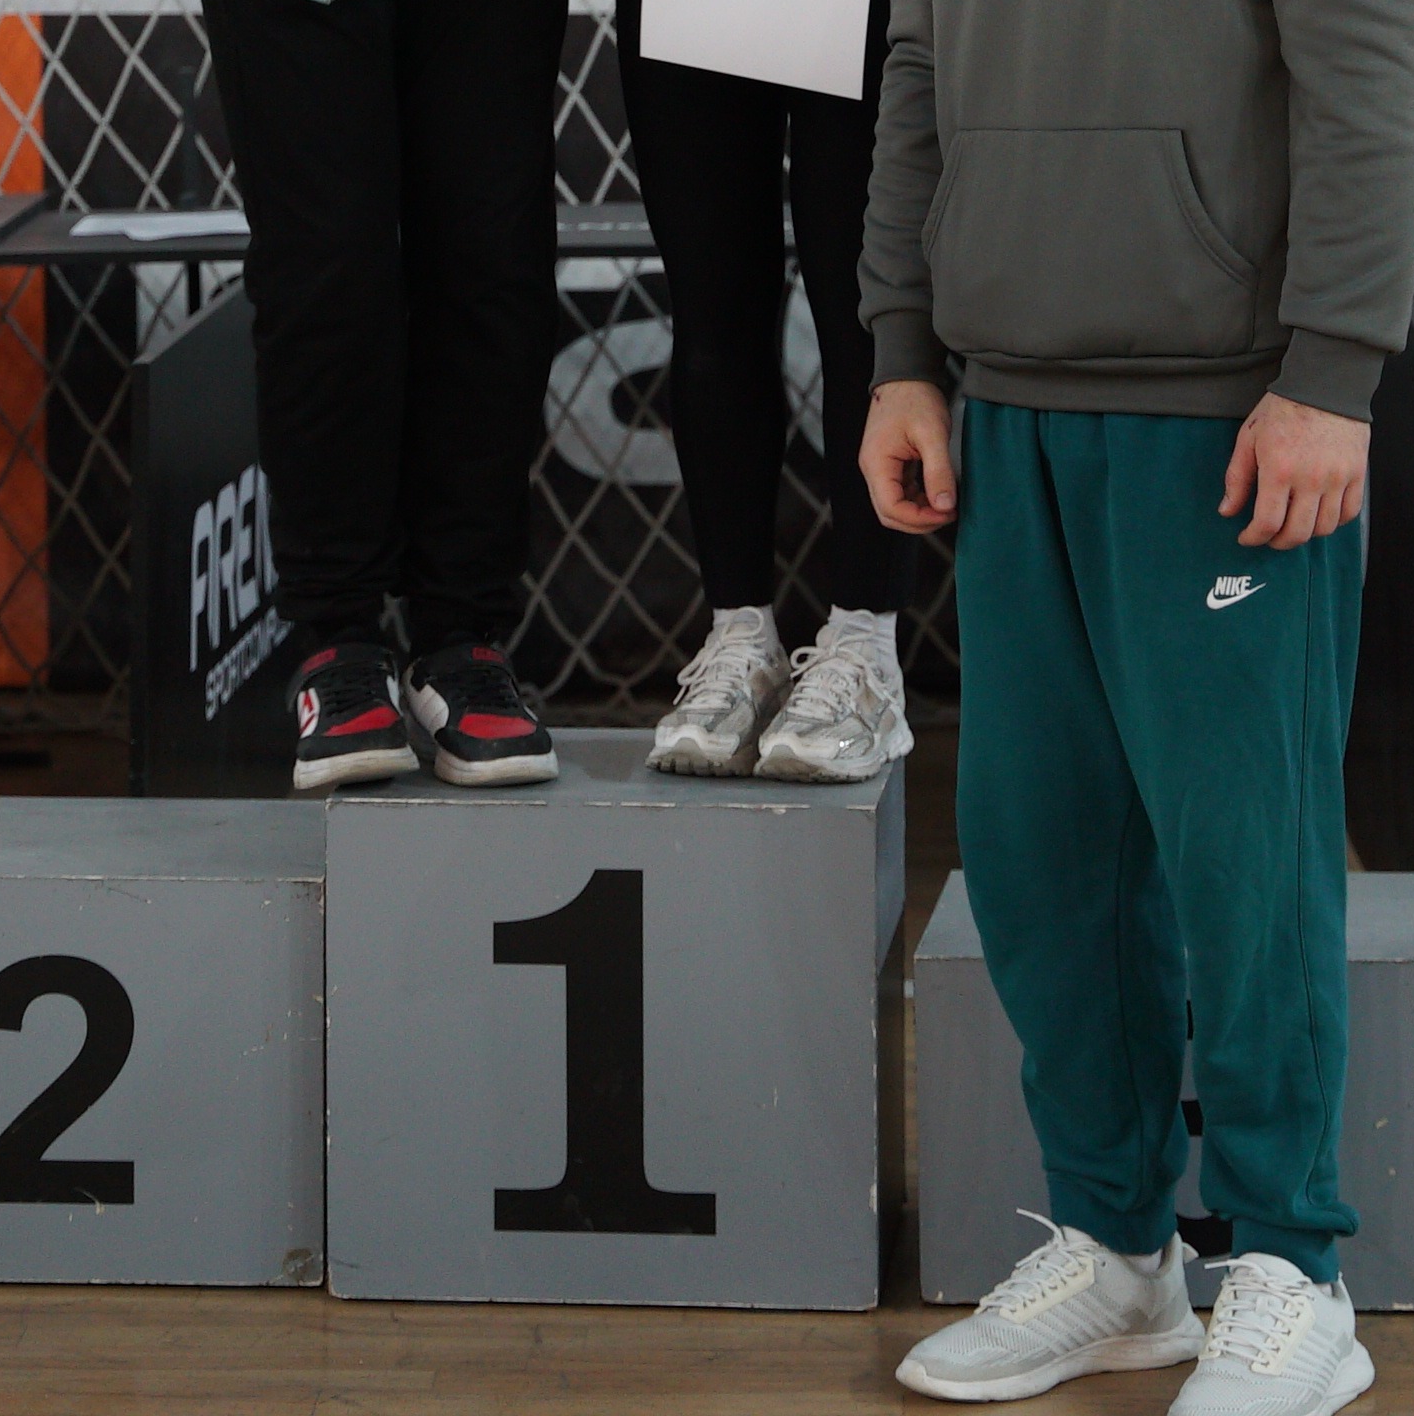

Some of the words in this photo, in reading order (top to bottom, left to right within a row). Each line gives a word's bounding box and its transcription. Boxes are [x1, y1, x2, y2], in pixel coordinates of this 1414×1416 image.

[189, 463, 280, 673] AREN
[1214, 576, 1252, 596] NIKE
[493, 869, 716, 1236] 1
